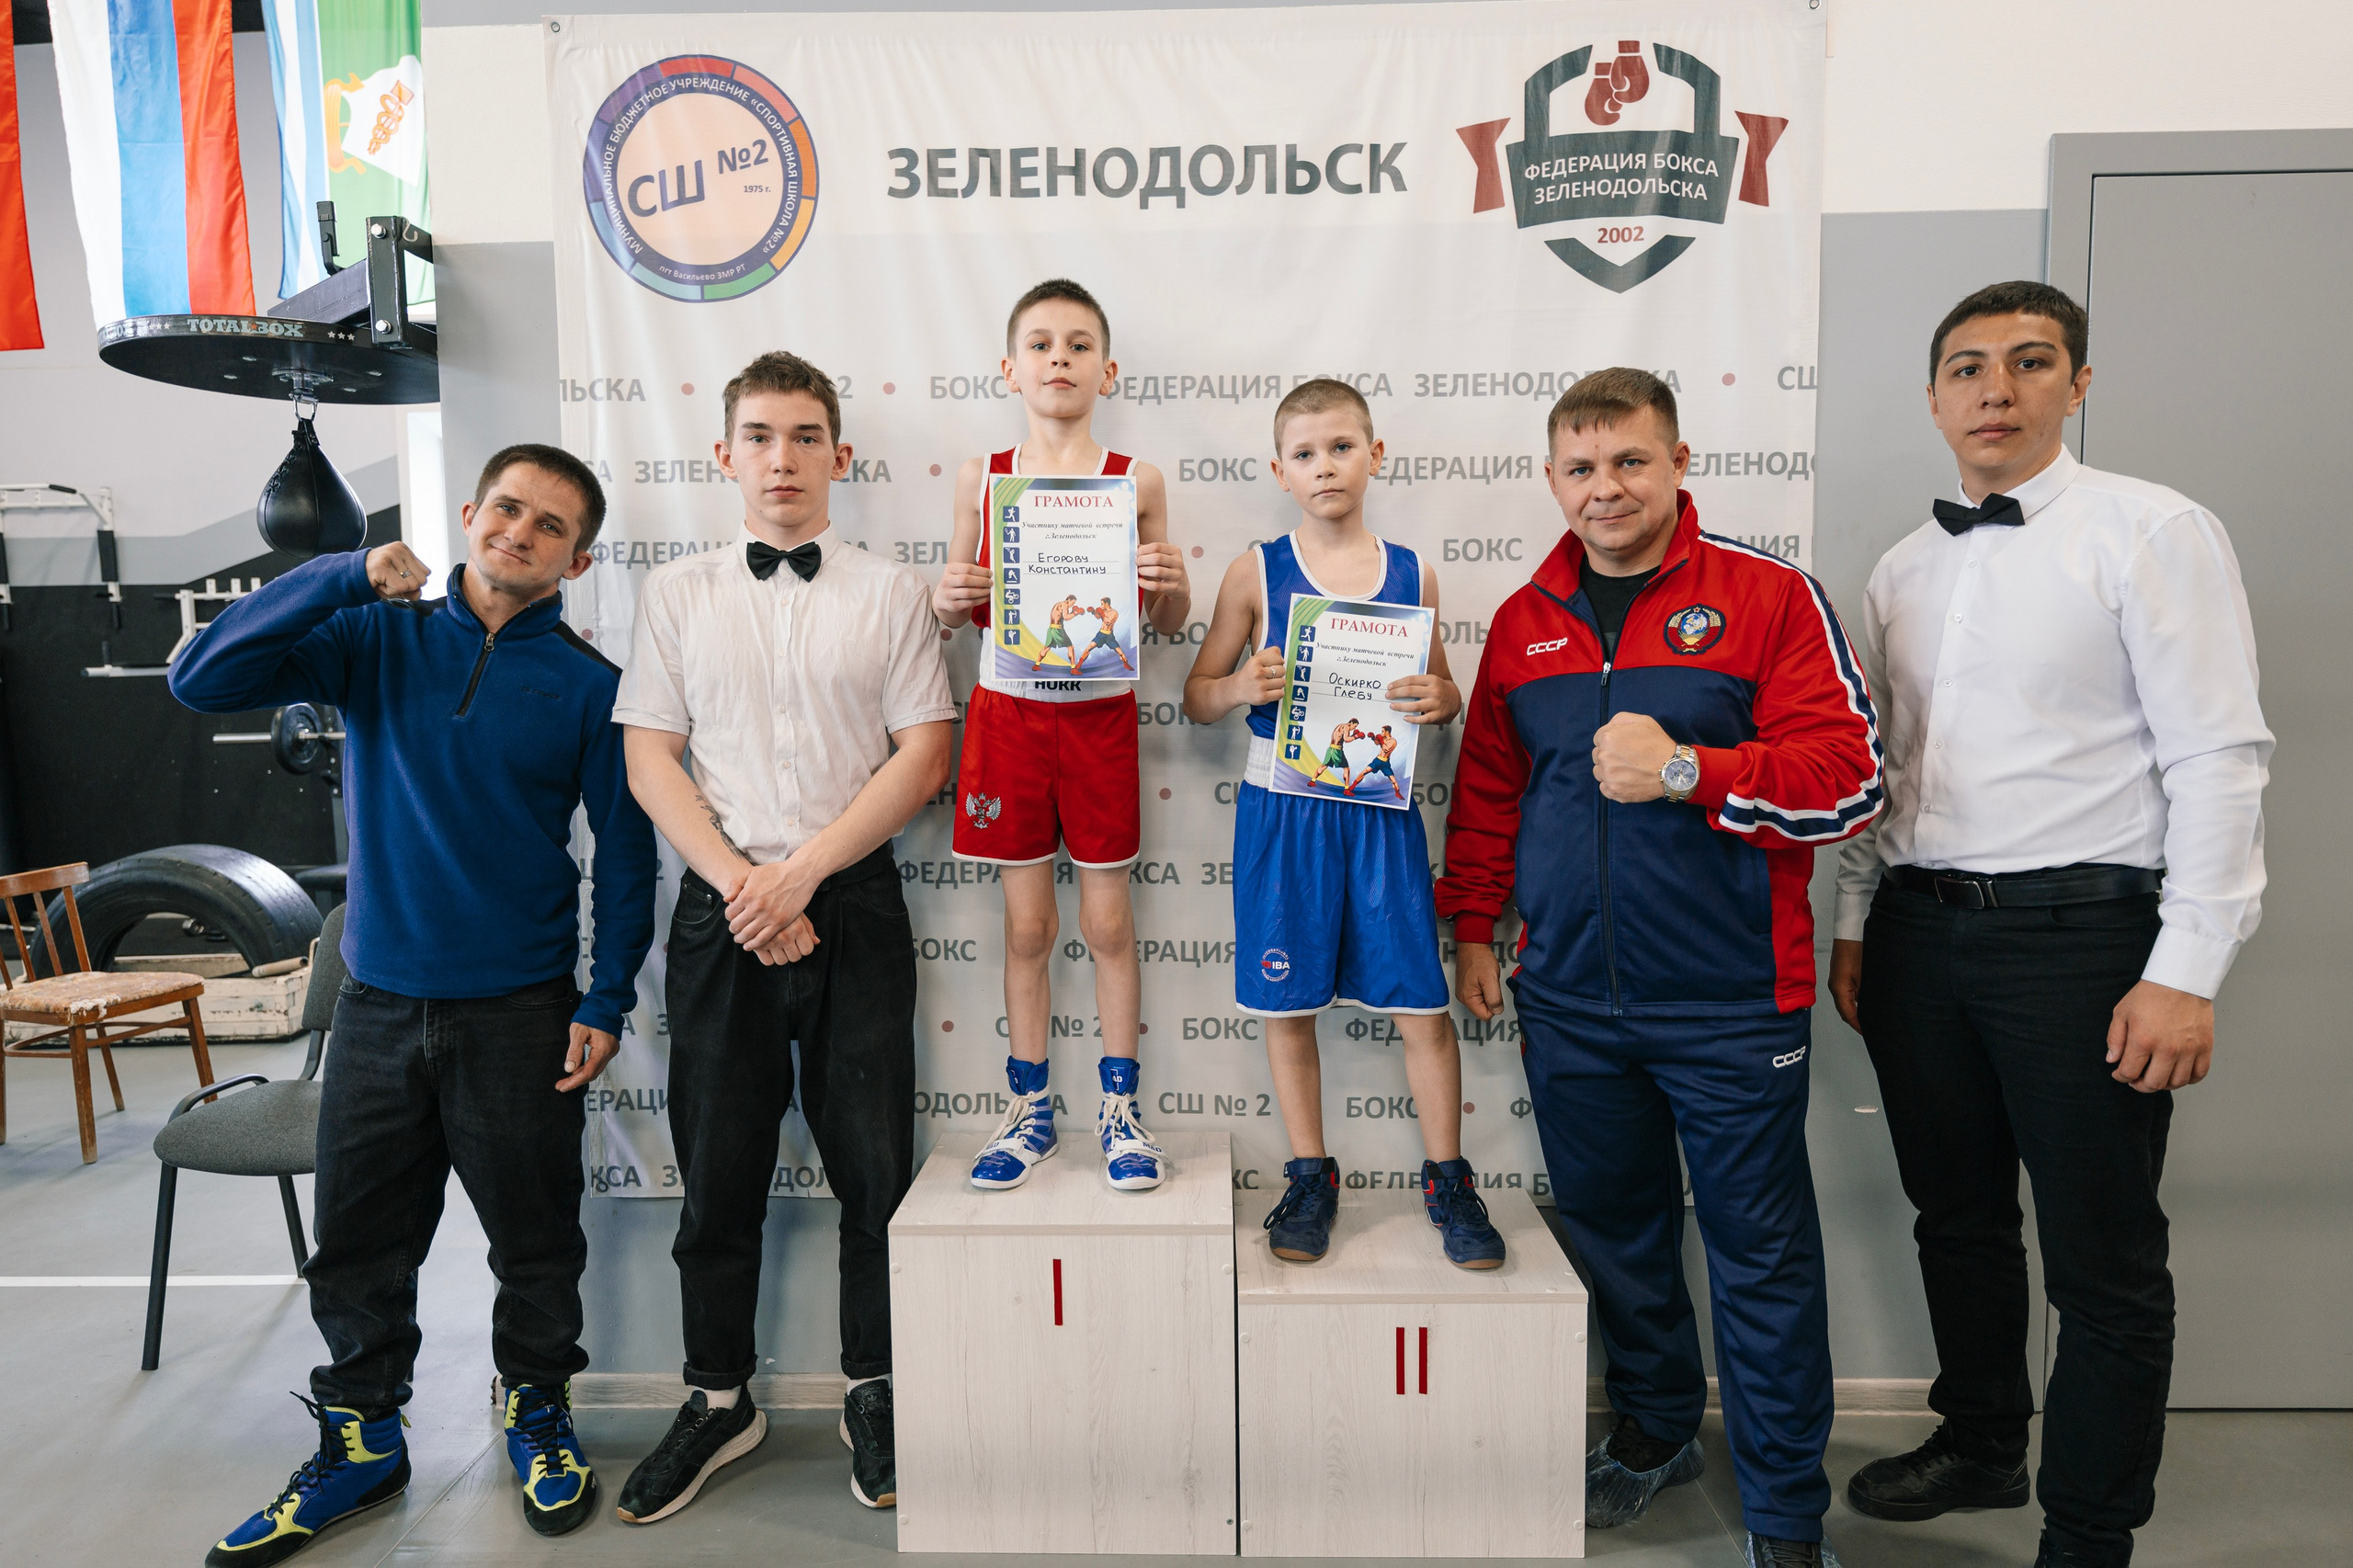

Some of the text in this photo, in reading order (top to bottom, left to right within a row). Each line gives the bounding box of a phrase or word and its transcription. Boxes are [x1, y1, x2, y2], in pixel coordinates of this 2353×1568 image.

[669, 77, 750, 102] УЧРЕЖДЕНИЕ
[609, 84, 669, 143] БЮДЖЕТНОЕ
[750, 98, 798, 176] «СПОРТИВНАЯ
[887, 142, 1408, 210] ЗЕЛЕНОДОЛЬСК
[1524, 153, 1719, 180] ФЕДЕРАЦИЯ БОКСА
[604, 144, 643, 254] МУНИЦИПАЛЬНОЕ
[628, 160, 705, 217] СШ
[744, 185, 763, 193] 1975
[1534, 178, 1708, 205] ЗЕЛЕНОДОЛЬСКА
[778, 181, 798, 228] ШКОЛА
[1597, 226, 1644, 244] 2002
[659, 264, 746, 280] пгт Васильево ЗМР РТ
[837, 375, 853, 399] 2
[930, 376, 1008, 400] БОКС
[1179, 458, 1256, 482] БОКС
[1035, 495, 1113, 507] ГРАМОТА
[1038, 552, 1088, 562] Егорову
[1443, 538, 1523, 562] БОКС
[1029, 564, 1106, 574] Константину
[1331, 618, 1408, 638] ГРАМОТА
[1315, 642, 1415, 659] Участнику матчевой встречи
[1329, 672, 1381, 689] Оскирко
[1334, 686, 1372, 700] Глебу
[1272, 961, 1290, 970] IBA
[1051, 1016, 1084, 1038] №
[1183, 1017, 1258, 1040] БОКС
[1158, 1092, 1204, 1114] СШ
[1214, 1095, 1246, 1116] №
[1256, 1094, 1271, 1116] 2
